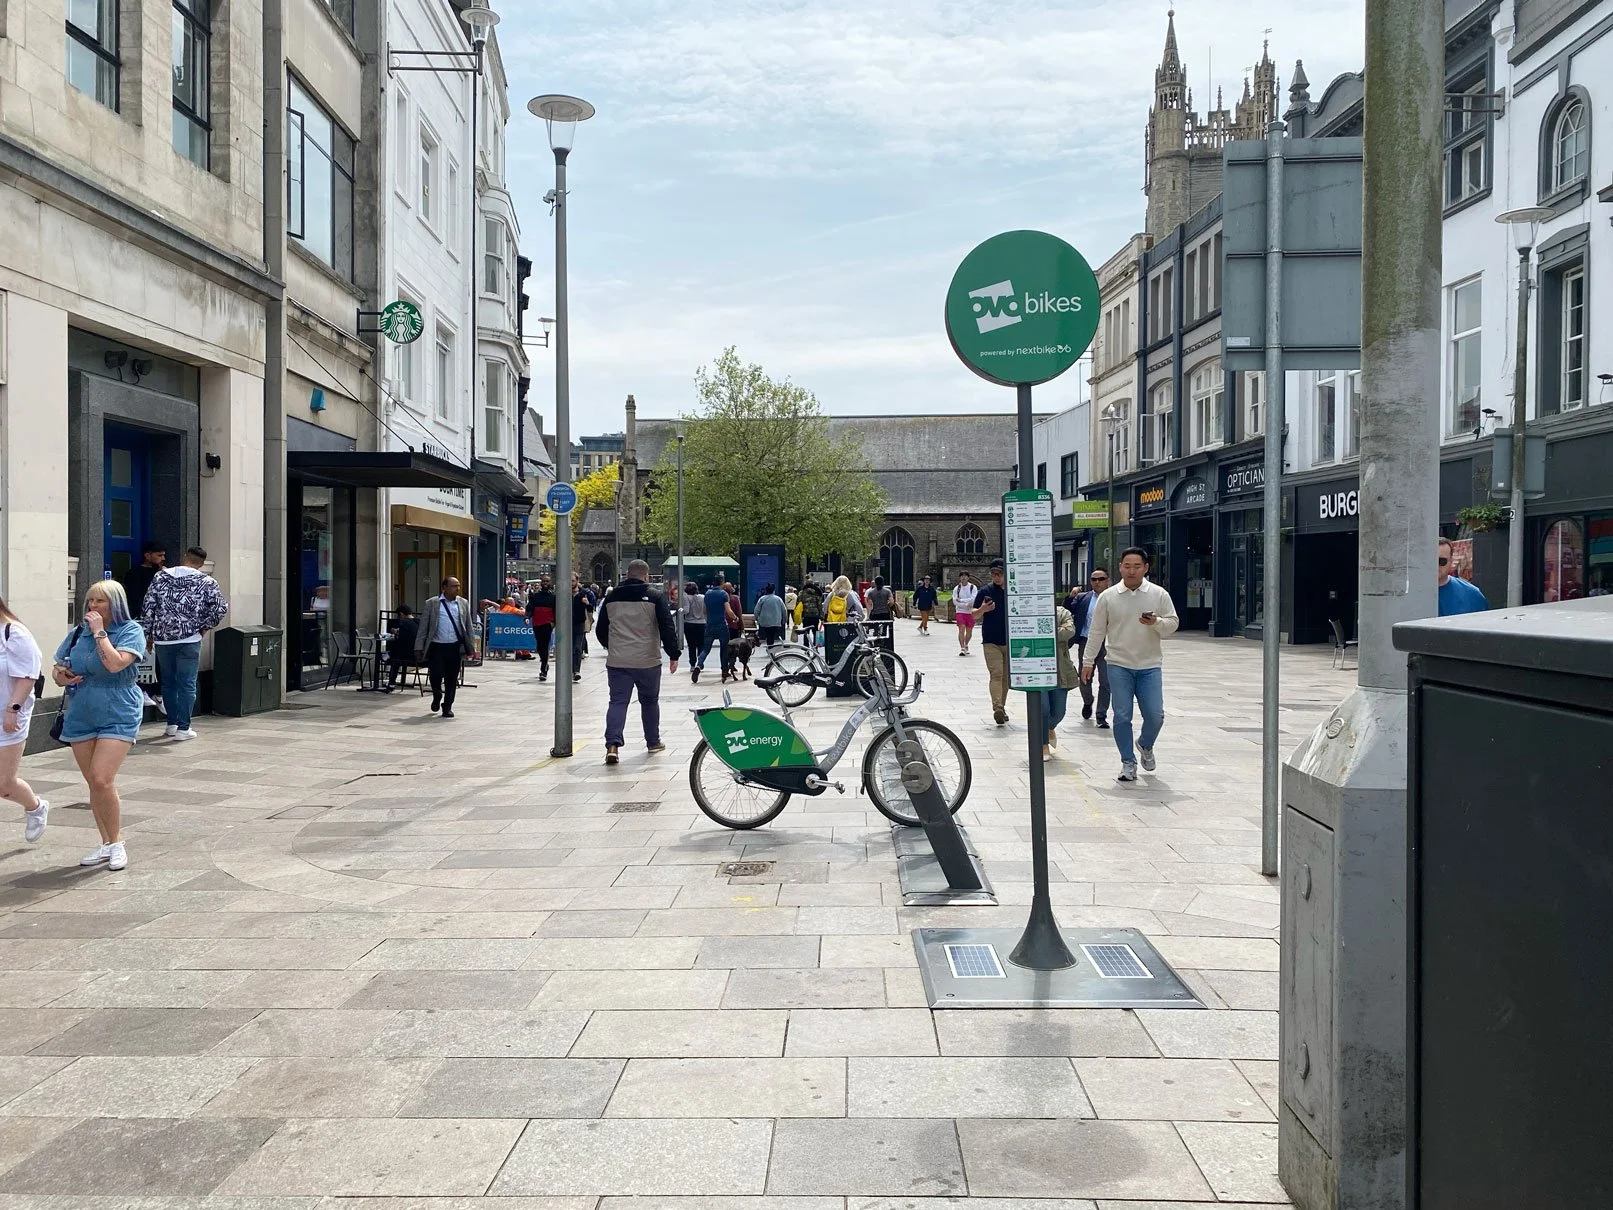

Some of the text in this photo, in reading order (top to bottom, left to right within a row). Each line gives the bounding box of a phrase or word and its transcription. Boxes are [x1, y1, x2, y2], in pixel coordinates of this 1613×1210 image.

[1025, 291, 1082, 314] bikes
[980, 345, 1057, 357] powered by nextbike
[1140, 486, 1164, 504] mooboo
[1186, 484, 1198, 495] HIGH
[1186, 493, 1205, 505] ARCADE
[1320, 490, 1360, 519] BURG
[750, 735, 783, 747] energy
